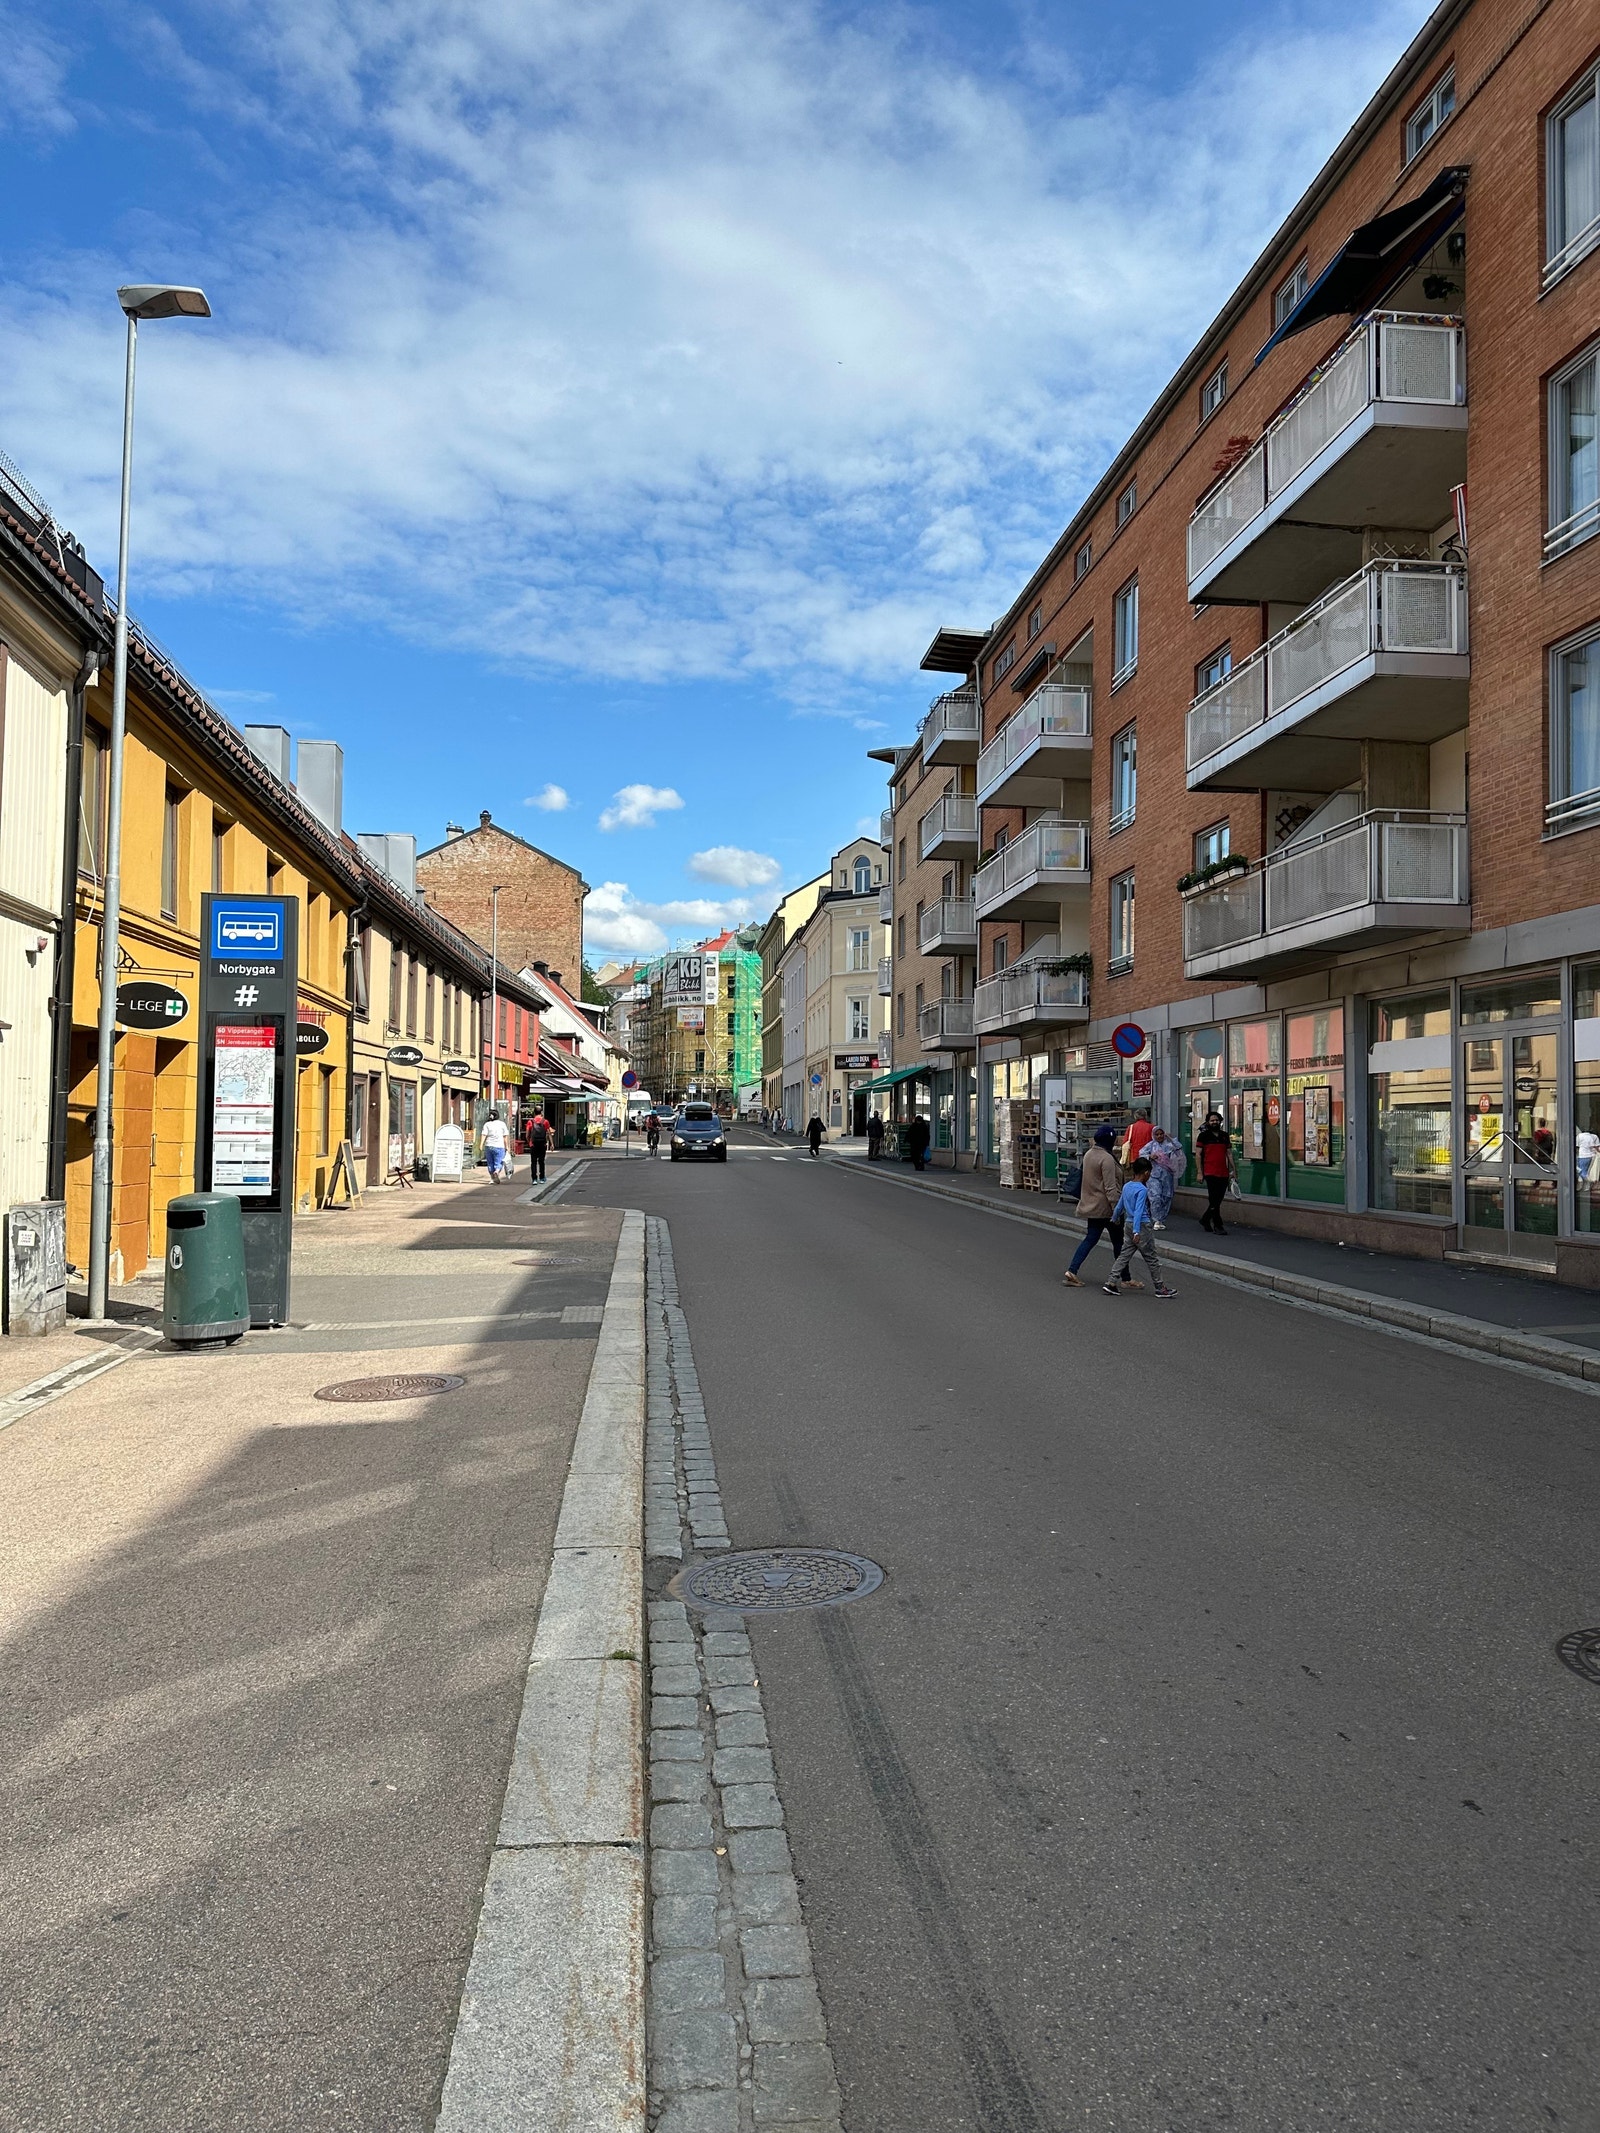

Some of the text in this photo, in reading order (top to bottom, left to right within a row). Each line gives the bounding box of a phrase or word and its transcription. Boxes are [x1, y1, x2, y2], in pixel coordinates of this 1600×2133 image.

[219, 964, 276, 976] Norbygata
[680, 958, 700, 978] KB
[680, 979, 700, 990] Blikk
[130, 1000, 163, 1012] LEGE
[1245, 1063, 1264, 1073] HALAL
[1268, 1101, 1280, 1115] ria
